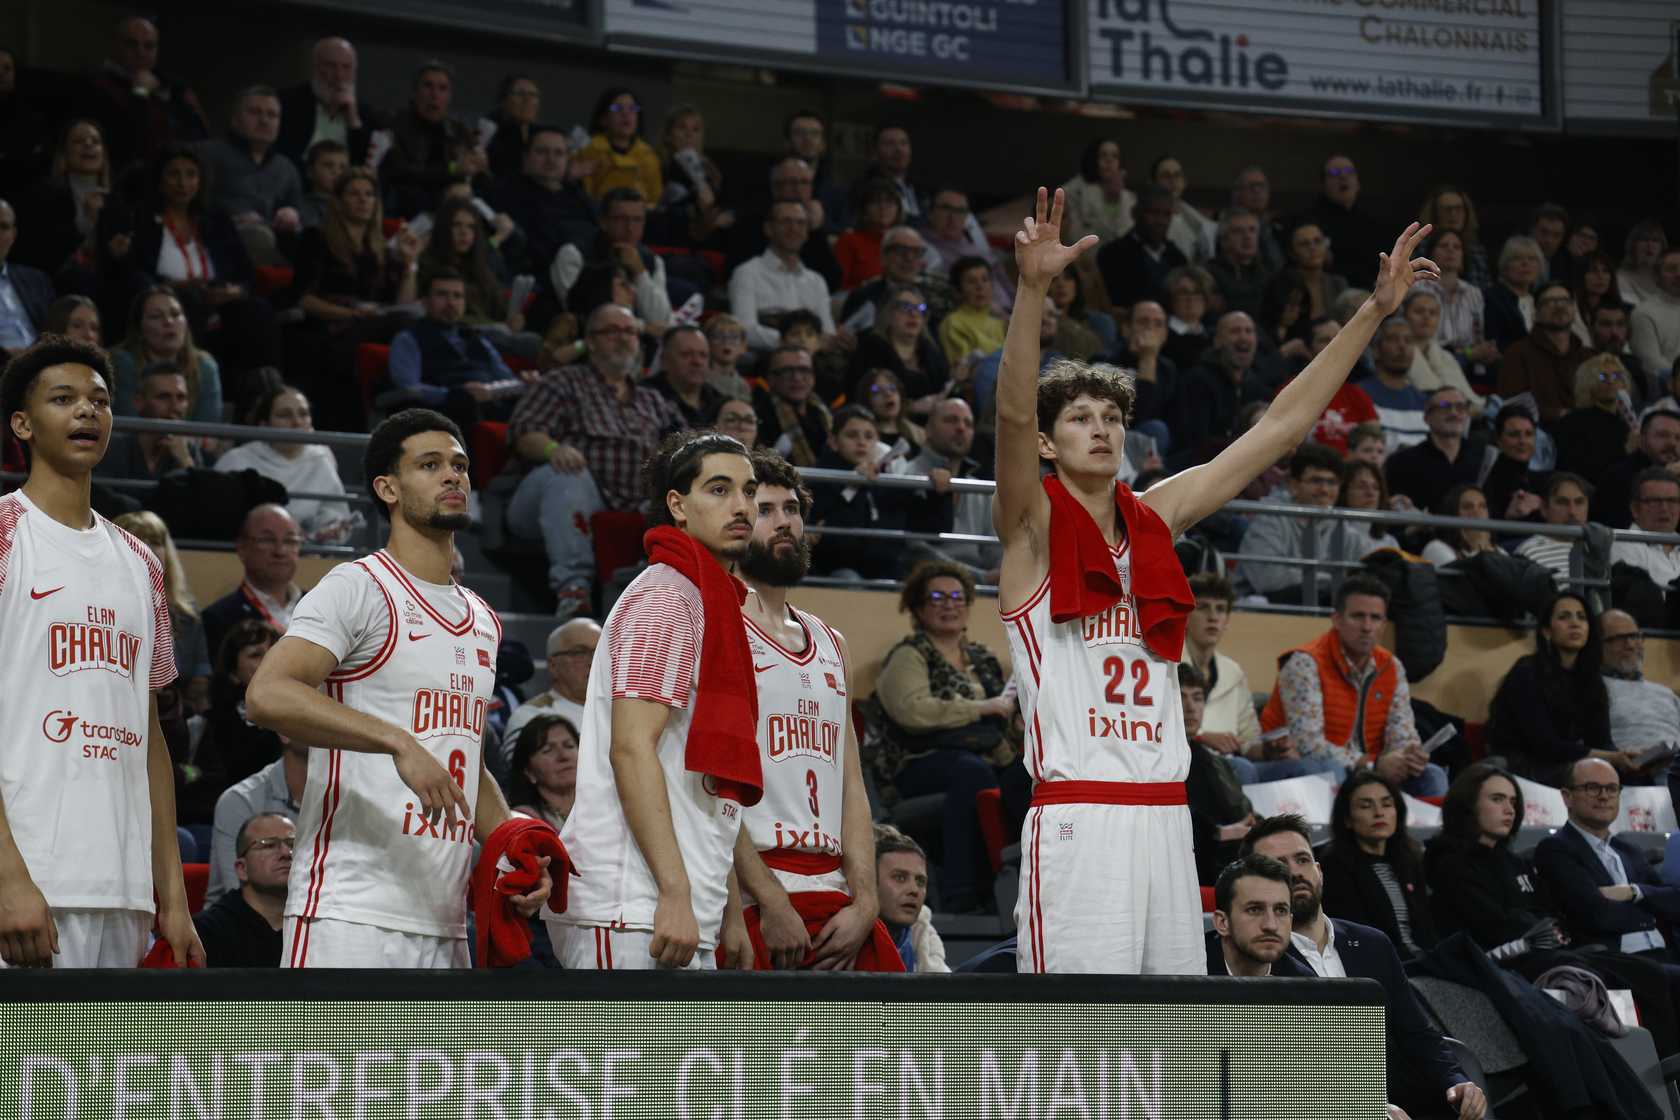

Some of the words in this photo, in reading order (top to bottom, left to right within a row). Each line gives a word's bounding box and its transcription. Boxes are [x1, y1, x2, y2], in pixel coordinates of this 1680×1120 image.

[869, 27, 926, 56] NGE
[931, 33, 970, 61] GC
[1358, 15, 1529, 53] CHALONNAIS
[1098, 27, 1288, 91] Thalie
[87, 605, 116, 627] ELAN
[1081, 604, 1148, 648] CHAL
[450, 672, 474, 693] ELAN
[1103, 655, 1154, 707] 22
[413, 688, 487, 743] CHALO
[797, 698, 820, 717] ELAN
[83, 744, 118, 761] STAC
[805, 768, 820, 818] 3
[20, 1047, 641, 1120] D'ENTREPRISE
[675, 1027, 818, 1120] CLÉ
[853, 1048, 945, 1120] EN
[979, 1046, 1163, 1120] MAIN
